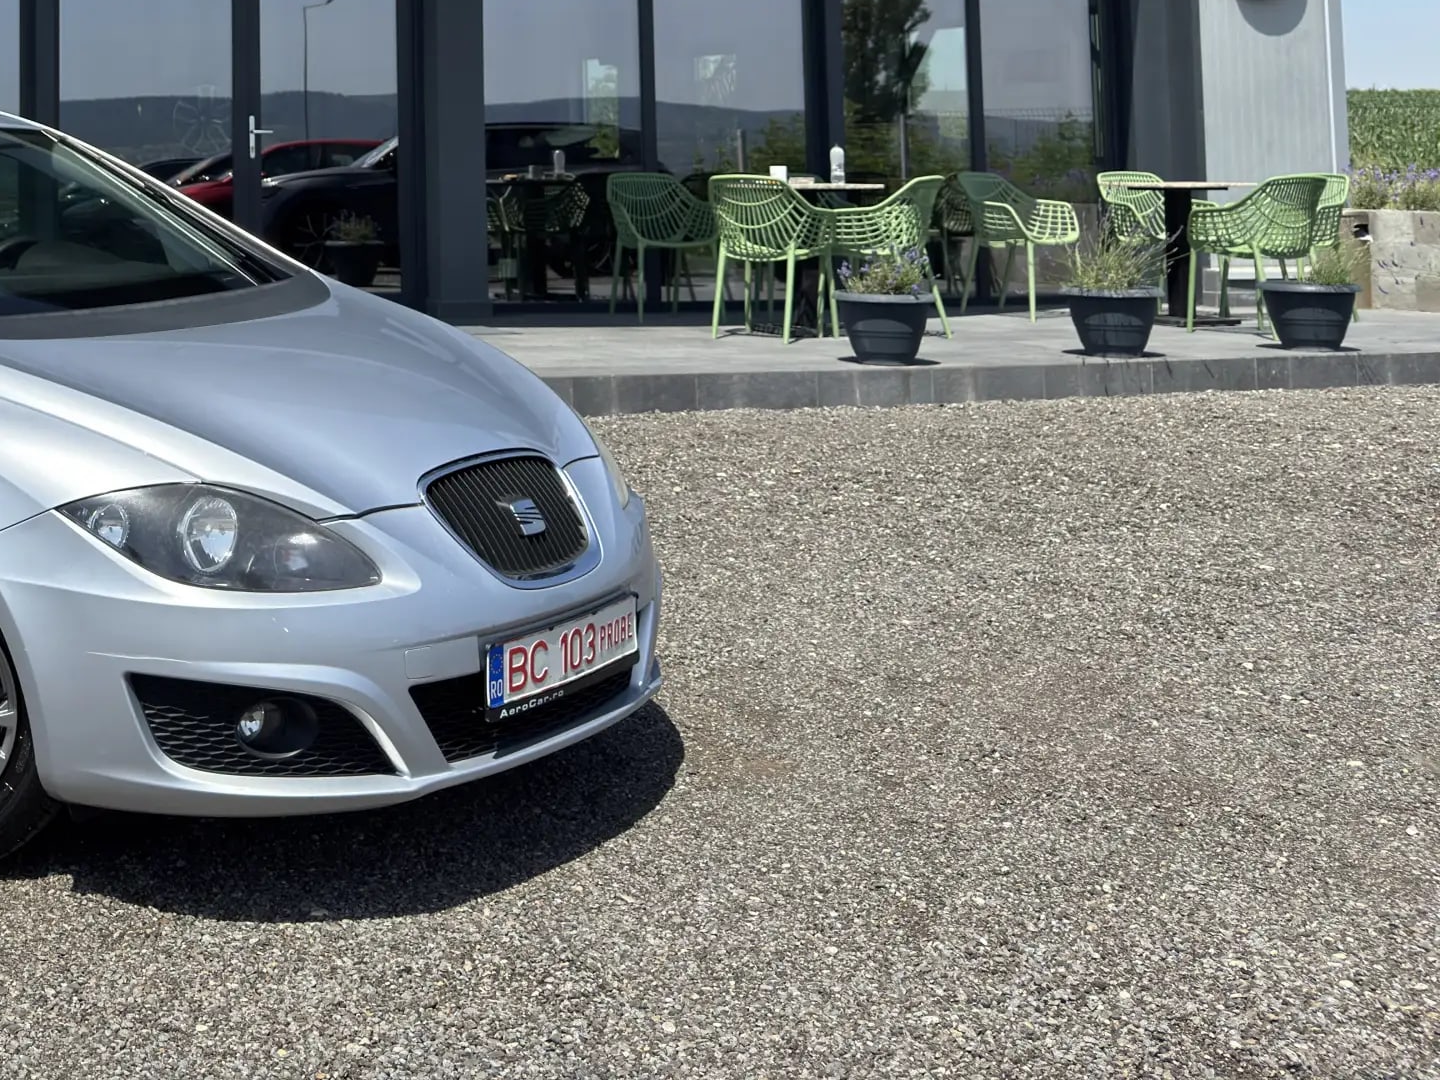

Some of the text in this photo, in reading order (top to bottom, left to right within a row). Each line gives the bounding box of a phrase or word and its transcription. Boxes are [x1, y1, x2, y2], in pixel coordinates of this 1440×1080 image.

[490, 613, 633, 700] RO BC 103 PROBE
[499, 690, 565, 719] AeroCar.ro
